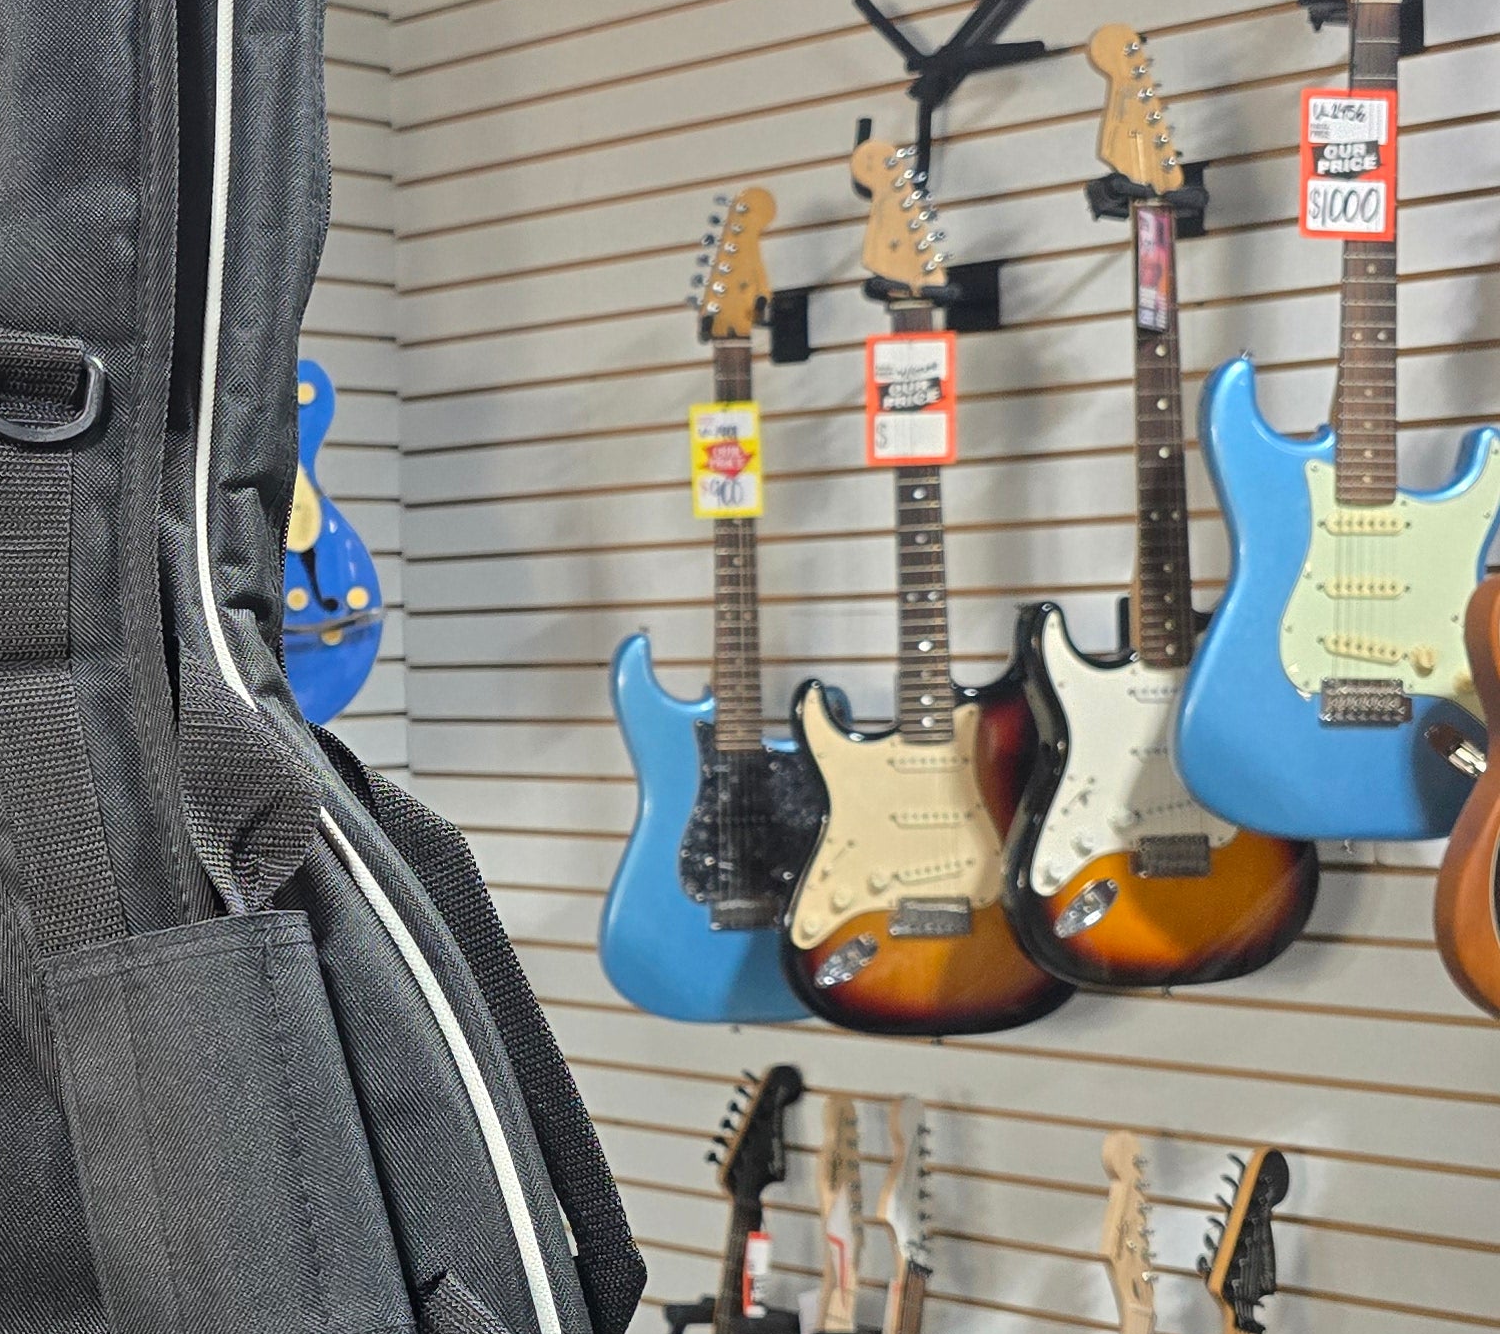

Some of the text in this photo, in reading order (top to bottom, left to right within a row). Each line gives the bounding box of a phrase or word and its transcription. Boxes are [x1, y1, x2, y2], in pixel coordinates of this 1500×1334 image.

[1323, 142, 1368, 160] OUR
[1316, 155, 1378, 175] PRICE
[1309, 187, 1380, 227] $1000
[882, 387, 942, 411] PRICE
[888, 380, 932, 398] OUR
